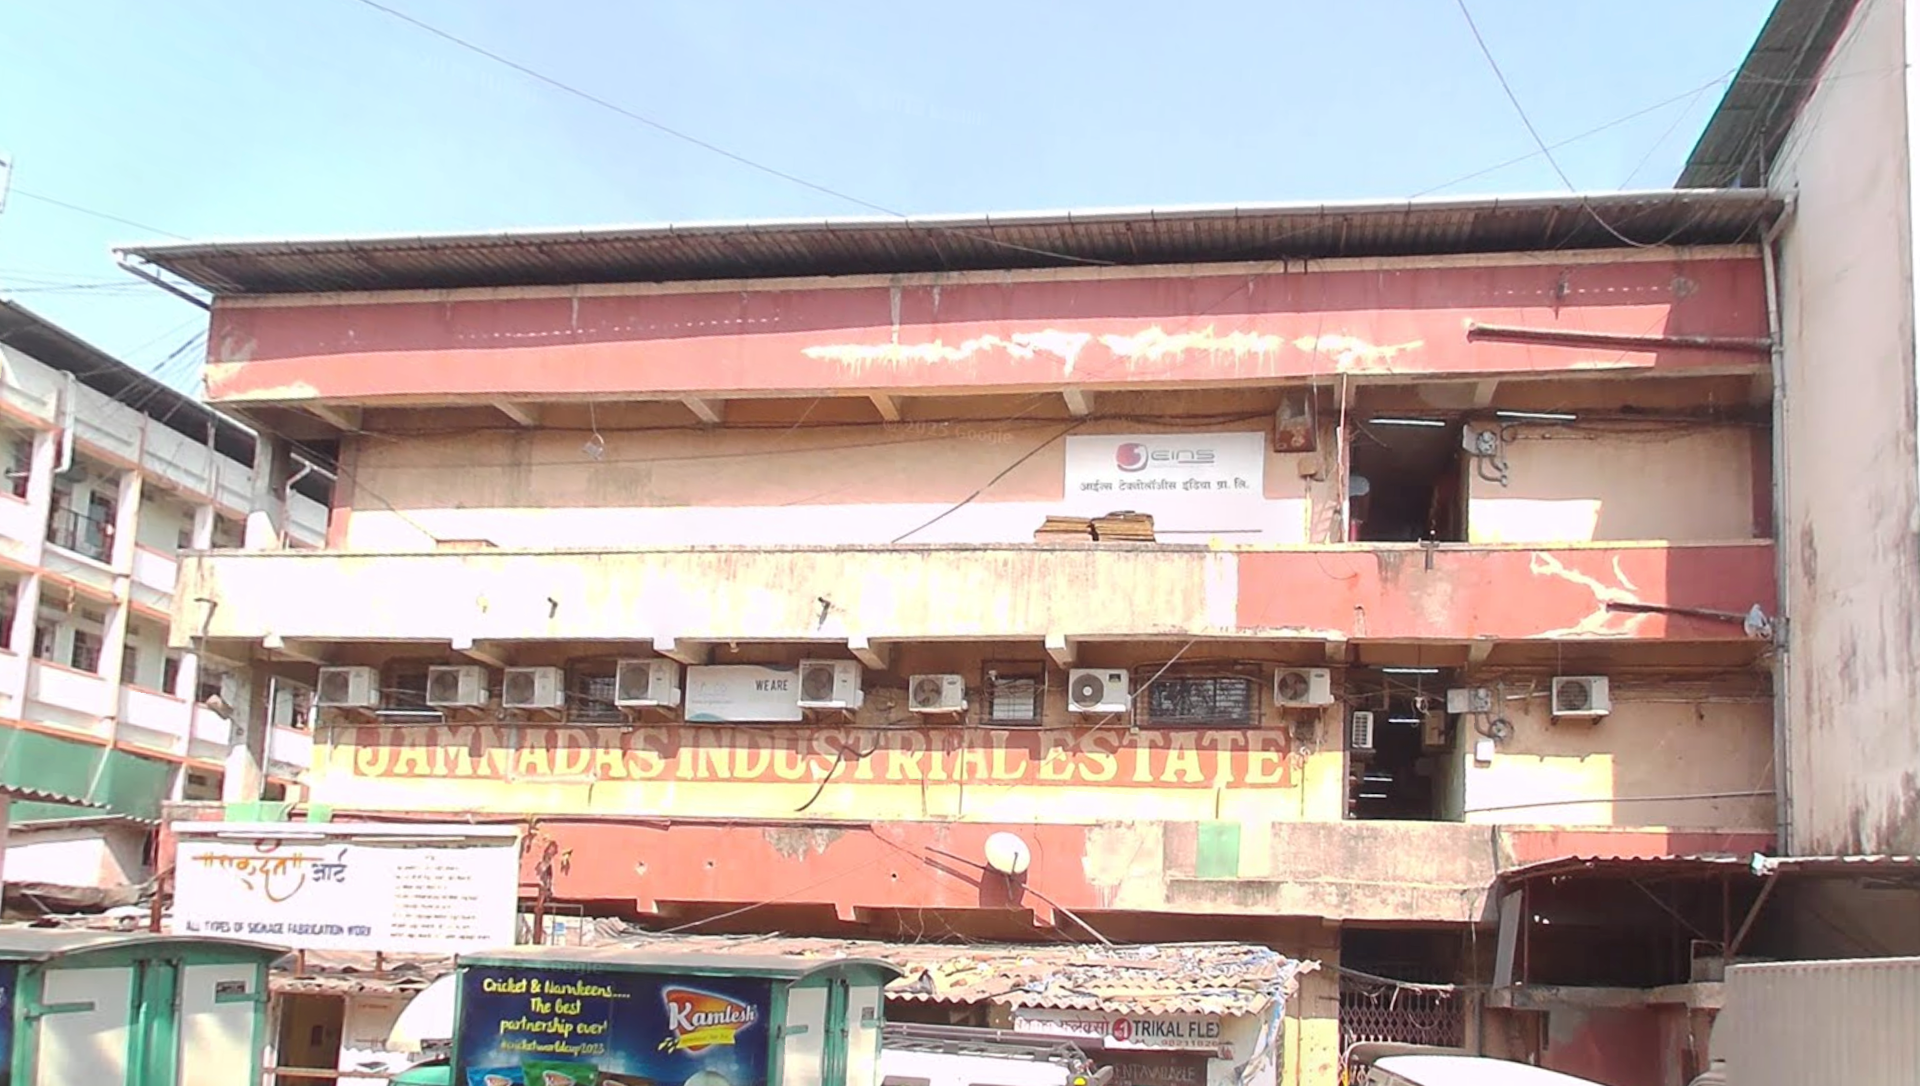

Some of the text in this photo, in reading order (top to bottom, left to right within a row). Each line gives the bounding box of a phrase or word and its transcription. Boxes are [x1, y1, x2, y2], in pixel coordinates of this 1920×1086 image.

[754, 679, 788, 692] WE ARE
[356, 725, 1286, 784] JAMNADAS INDUSTRIAL ESTATE
[204, 922, 231, 932] TYPES
[234, 922, 245, 932] OF
[287, 924, 344, 935] FABRICATION
[483, 977, 528, 993] Cricket
[530, 978, 541, 993] &
[530, 997, 581, 1015] The best
[668, 1002, 755, 1031] Kamlesh
[500, 1015, 574, 1038] partnership
[1133, 1020, 1184, 1037] TRIKAL
